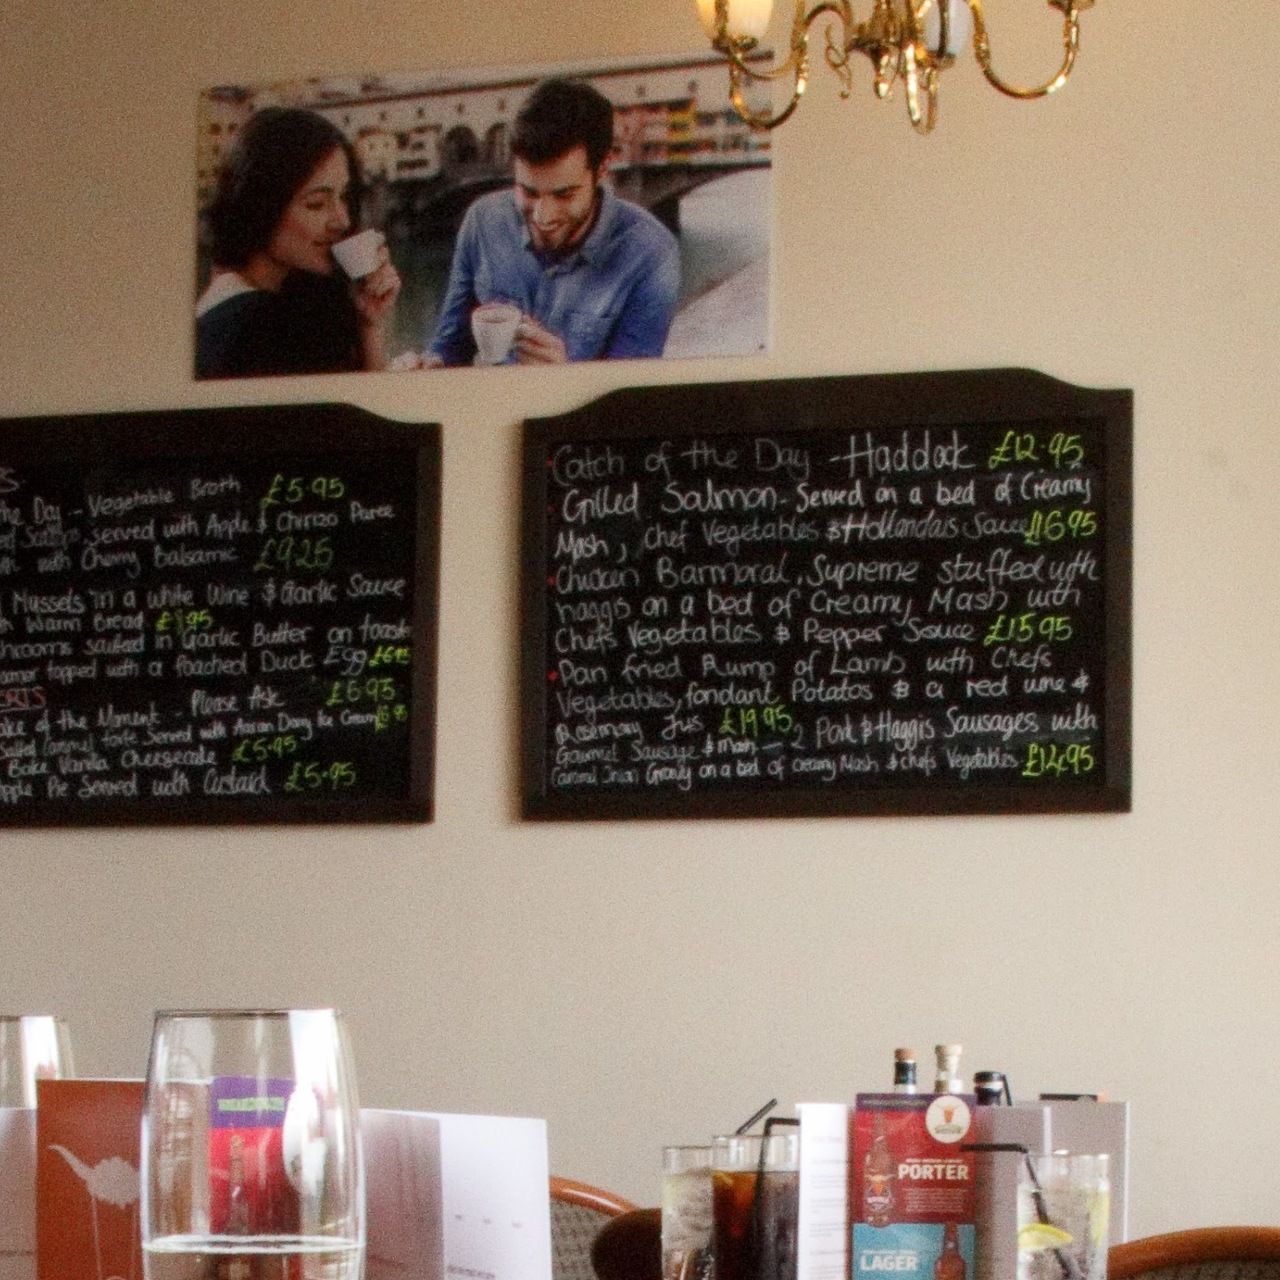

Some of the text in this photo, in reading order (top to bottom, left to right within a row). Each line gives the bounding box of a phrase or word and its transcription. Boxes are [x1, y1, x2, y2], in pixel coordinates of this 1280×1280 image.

[552, 444, 624, 486] Catch
[645, 440, 672, 482] of
[680, 438, 738, 470] the
[754, 437, 810, 481] Day
[988, 430, 1084, 470] £12.95
[259, 473, 346, 508] £5.95
[563, 483, 640, 524] Grilled
[875, 485, 897, 505] on
[909, 486, 923, 505] a
[937, 480, 976, 506] bed
[995, 472, 1011, 505] of
[806, 553, 920, 591] Supreme
[936, 547, 1045, 595] stuffed
[13, 588, 85, 614] Mussels
[122, 592, 137, 608] a
[642, 595, 668, 617] on
[680, 595, 696, 616] a
[708, 589, 752, 617] bed
[767, 588, 800, 619] of
[810, 590, 913, 627] Creamy
[928, 586, 1010, 615] Mash
[1027, 582, 1082, 608] with
[252, 622, 314, 647] Butter
[627, 616, 762, 655] Vegetables
[804, 617, 888, 652] Pepper
[902, 617, 977, 642] Sauce
[261, 650, 315, 673] Duck
[322, 645, 368, 677] Egg
[558, 657, 609, 688] Pan
[621, 652, 683, 684] fried
[702, 653, 776, 681] Rump
[793, 650, 821, 682] of
[831, 648, 907, 676] Lamb
[926, 647, 976, 675] with
[686, 681, 782, 706] fondant
[925, 682, 945, 700] a
[966, 675, 1010, 699] red
[942, 705, 1040, 743] Sausages
[898, 1164, 969, 1181] PORTER
[860, 1254, 918, 1272] LAGER
